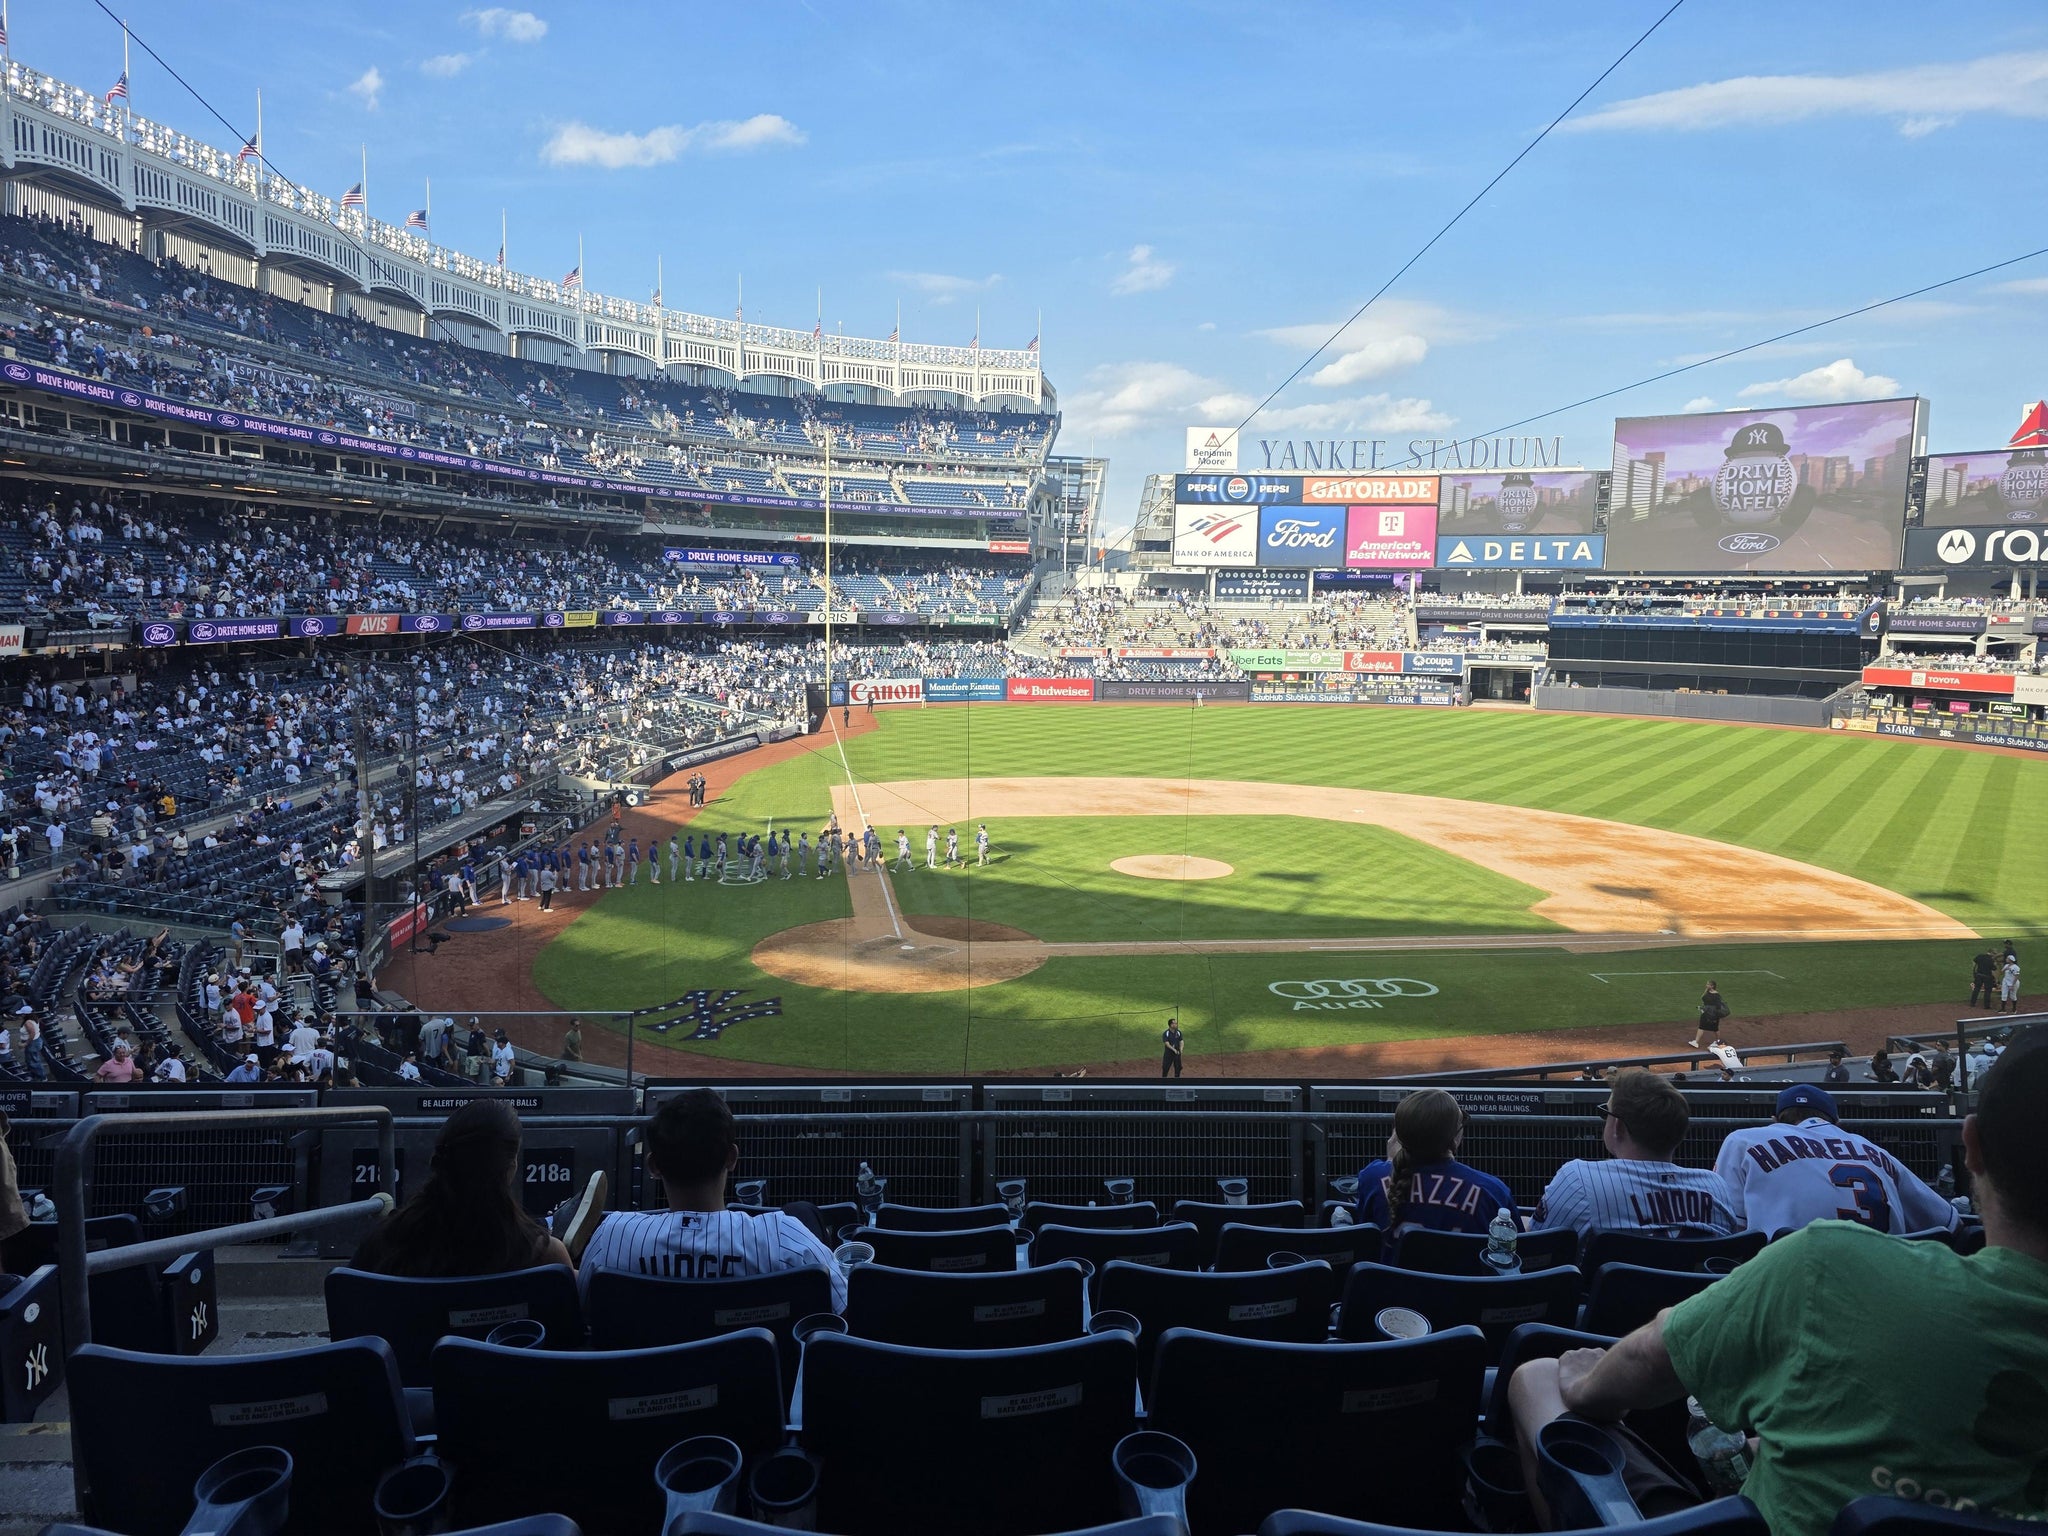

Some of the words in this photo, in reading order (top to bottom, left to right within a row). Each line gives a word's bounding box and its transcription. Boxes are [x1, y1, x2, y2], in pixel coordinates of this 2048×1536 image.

[10, 366, 26, 380] Ford
[36, 372, 62, 389] DRIVE
[64, 380, 87, 394] HOME
[88, 385, 116, 400] SAFELY
[145, 398, 166, 412] DRIVE
[167, 404, 185, 416] HOME
[186, 408, 212, 422] SAFELY
[385, 400, 410, 414] VODKA
[244, 420, 267, 432] DRIVE
[268, 424, 288, 435] HOME
[289, 427, 313, 440] SAFELY
[340, 437, 359, 448] DRIVE
[360, 440, 377, 450] HOME
[378, 442, 397, 454] SAFELY
[1194, 448, 1232, 458] Benjamin
[1258, 440, 1386, 469] YANKEE
[1407, 436, 1564, 470] STADIUM
[418, 452, 434, 460] DRIVE
[434, 454, 449, 463] HOME
[450, 457, 466, 466] SAFELY
[1198, 458, 1225, 466] Moore
[1725, 464, 1786, 480] DRIVE
[2007, 470, 2046, 480] DRIVE
[542, 474, 556, 482] DRIVE
[1188, 484, 1217, 492] PEPSI
[1260, 485, 1290, 494] PEPSI
[1311, 482, 1432, 498] GATORADE
[1726, 480, 1785, 495] HOME
[2007, 480, 2046, 490] HOME
[674, 490, 690, 498] DRIVE
[1502, 490, 1533, 498] DRIVE
[2004, 490, 2047, 500] SAFELY
[1502, 498, 1533, 506] HOME
[1721, 496, 1786, 510] SAFELY
[1501, 506, 1533, 514] SAFELY
[2012, 511, 2032, 520] Ford
[1267, 519, 1337, 548] Ford
[1359, 540, 1422, 550] America's
[1730, 536, 1768, 550] Ford
[1349, 550, 1376, 560] Best
[1378, 550, 1432, 560] Network
[1484, 542, 1593, 561] DELTA
[688, 552, 715, 560] DRIVE
[717, 553, 741, 562] HOME
[742, 554, 773, 564] SAFELY
[420, 618, 436, 629] Ford
[468, 616, 482, 628] Ford
[515, 616, 532, 624] SAFELY
[818, 614, 848, 622] ORIS
[954, 615, 974, 623] Poland
[976, 615, 994, 624] Spring
[305, 620, 320, 633] Ford
[359, 616, 389, 632] AVIS
[151, 626, 170, 640] Ford
[196, 625, 214, 639] Ford
[218, 626, 238, 636] DRIVE
[238, 625, 257, 634] HOME
[258, 624, 278, 634] SAFELY
[1258, 656, 1283, 666] Eats
[1426, 656, 1453, 667] coupa
[1928, 676, 1960, 684] TOYOTA
[929, 682, 968, 691] Montefiore
[970, 682, 1000, 691] Einstein
[1128, 688, 1156, 696] DRIVE
[850, 683, 921, 702] Canon
[1388, 696, 1414, 704] STARR
[1993, 704, 2022, 713] ARENA
[1884, 724, 1916, 736] STARR
[1939, 730, 1951, 738] 385
[1976, 734, 2005, 745] StubHub
[2006, 737, 2034, 748] StubHub
[1293, 999, 1384, 1010] Audi
[432, 1028, 439, 1040] 7
[1724, 1048, 1736, 1058] 63
[7, 1093, 28, 1102] OVER,
[1466, 1094, 1482, 1102] LEAN
[1484, 1094, 1496, 1102] ON,
[1497, 1095, 1519, 1103] REACH
[1520, 1095, 1540, 1104] OVER,
[456, 1100, 468, 1108] FOR
[516, 1099, 537, 1107] BALLS
[1498, 1105, 1532, 1113] RAILINGS.
[526, 1164, 571, 1183] 218a
[1381, 1172, 1481, 1216] PAZZA
[1828, 1164, 1890, 1232] 3
[1630, 1190, 1714, 1226] LINDOR
[650, 1397, 672, 1406] ALERT
[674, 1394, 689, 1402] FOR
[679, 1399, 702, 1409] BALLS
